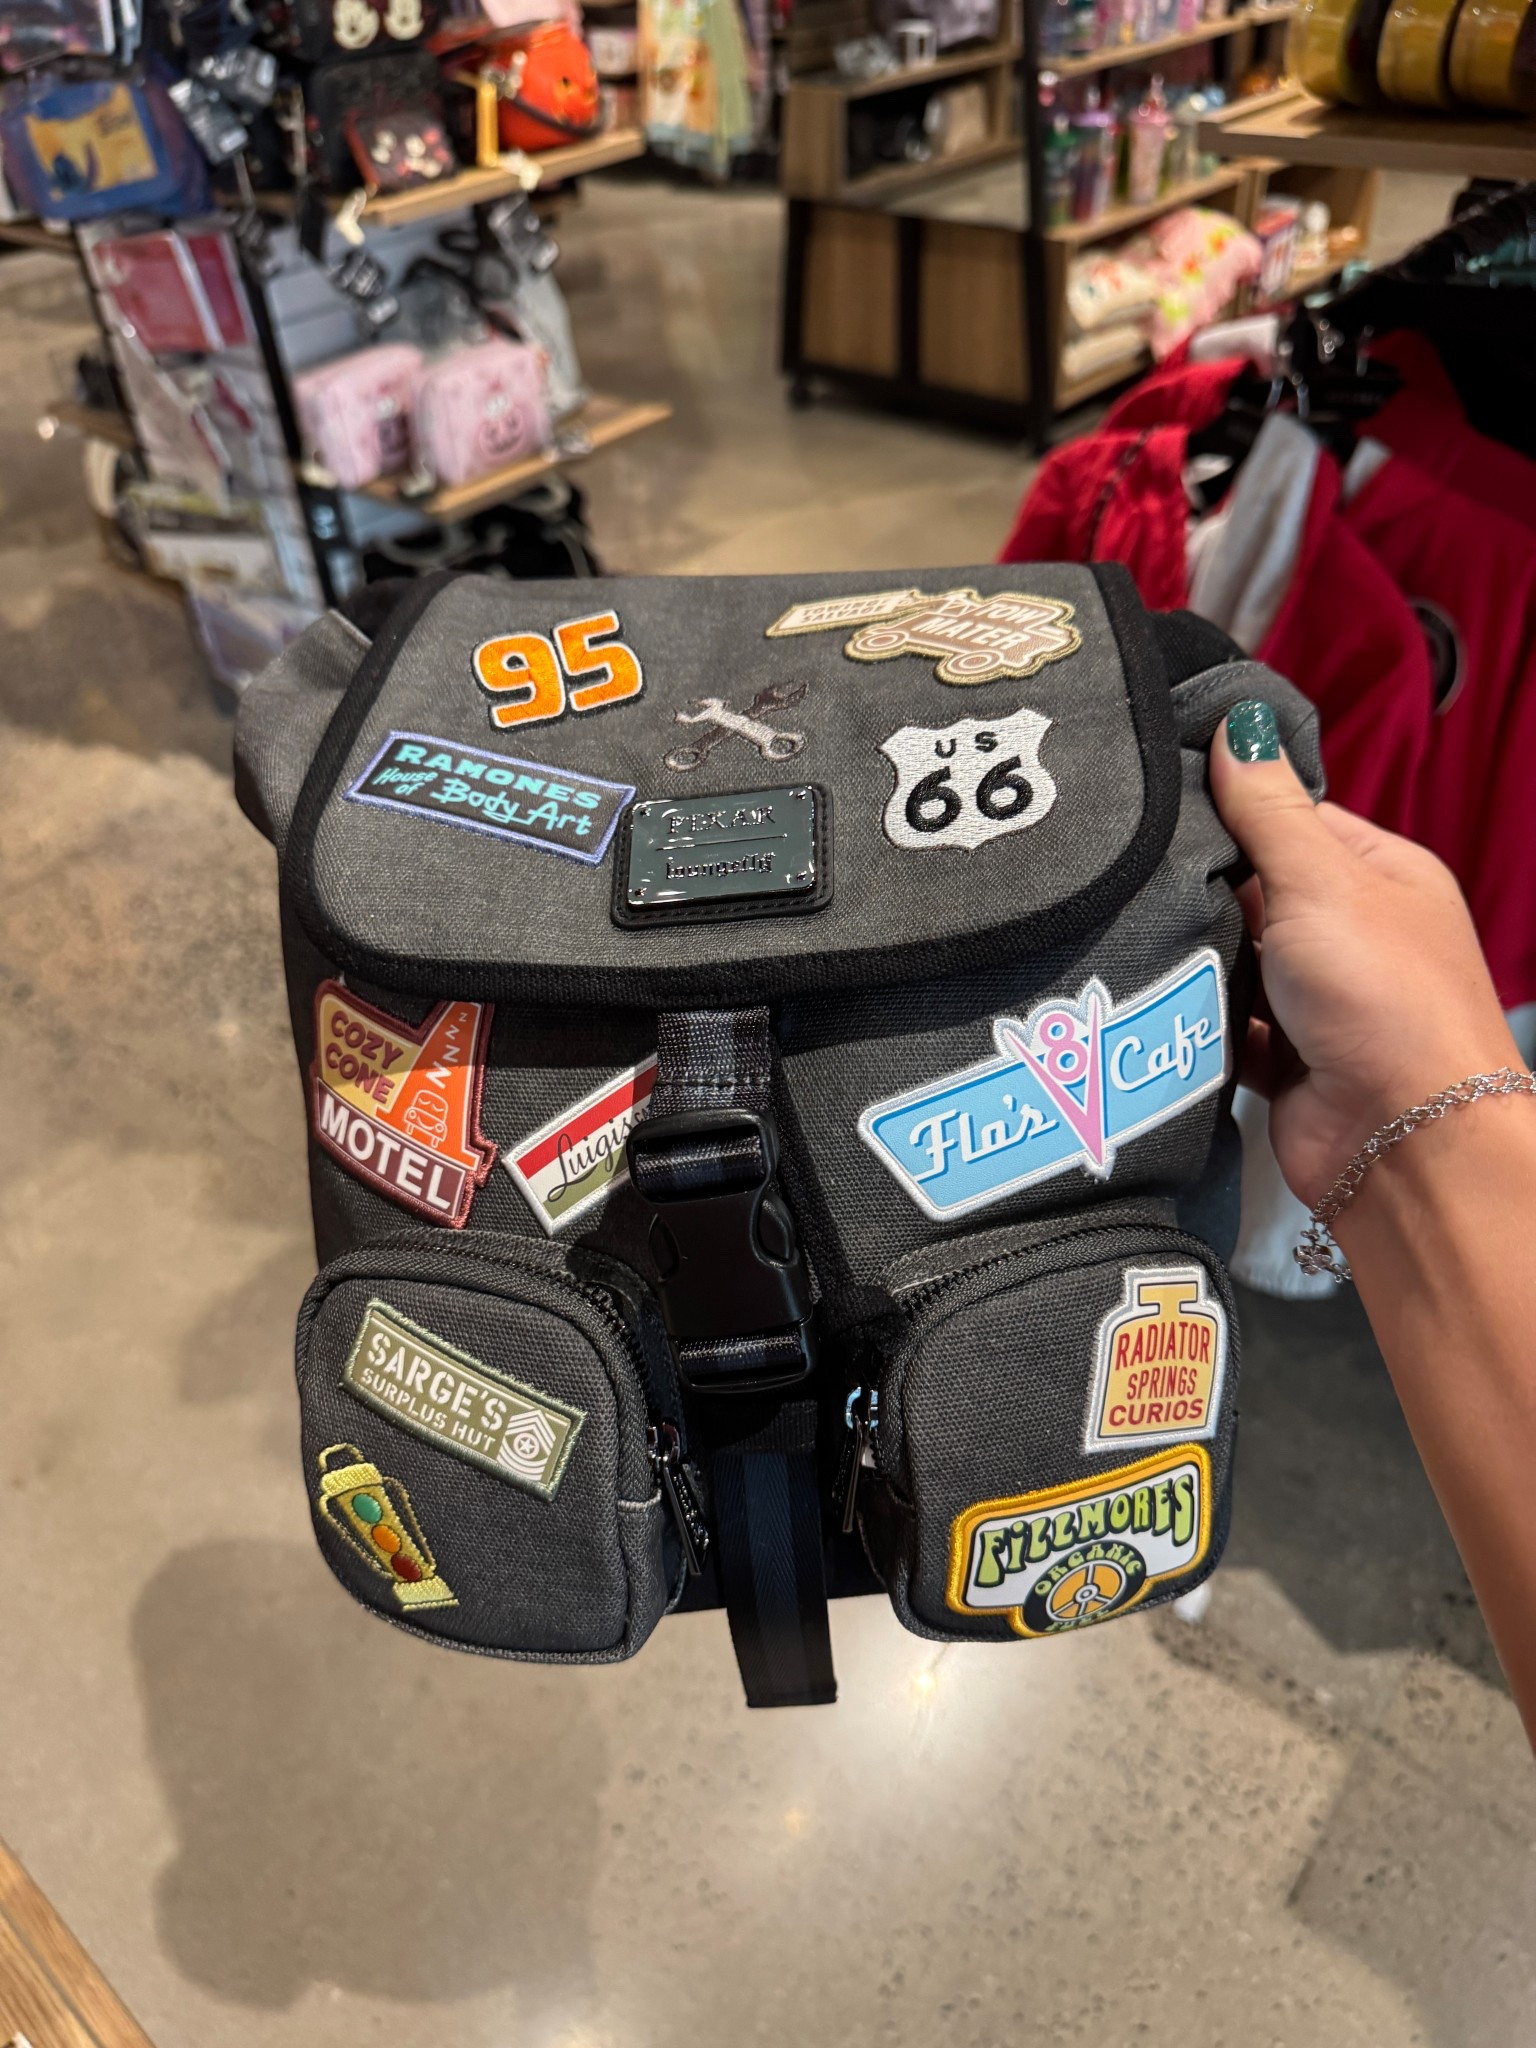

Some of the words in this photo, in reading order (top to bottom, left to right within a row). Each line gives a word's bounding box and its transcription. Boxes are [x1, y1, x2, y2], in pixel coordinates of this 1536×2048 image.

[911, 617, 1031, 649] MATER
[975, 602, 1039, 624] TOW
[473, 609, 644, 729] 95
[372, 767, 438, 785] House
[394, 744, 602, 810] RAMONES
[394, 782, 425, 796] of
[905, 755, 1034, 833] 66
[430, 778, 521, 824] Body
[527, 800, 593, 836] Art
[667, 806, 776, 835] PIXAR
[331, 1010, 404, 1070] COZY
[326, 1043, 395, 1104] CONE
[909, 1094, 1060, 1182] Flo's
[1110, 1013, 1223, 1092] Cafe
[320, 1093, 451, 1210] MOTEL
[1115, 1321, 1211, 1371] RADIATOR
[361, 1367, 448, 1431] SURPLUS
[451, 1420, 497, 1453] HUT
[367, 1332, 508, 1431] SARGE'S
[1126, 1365, 1198, 1401] SPRINGS
[1108, 1398, 1204, 1427] CURIOS
[1034, 1543, 1142, 1596] ORGANIC
